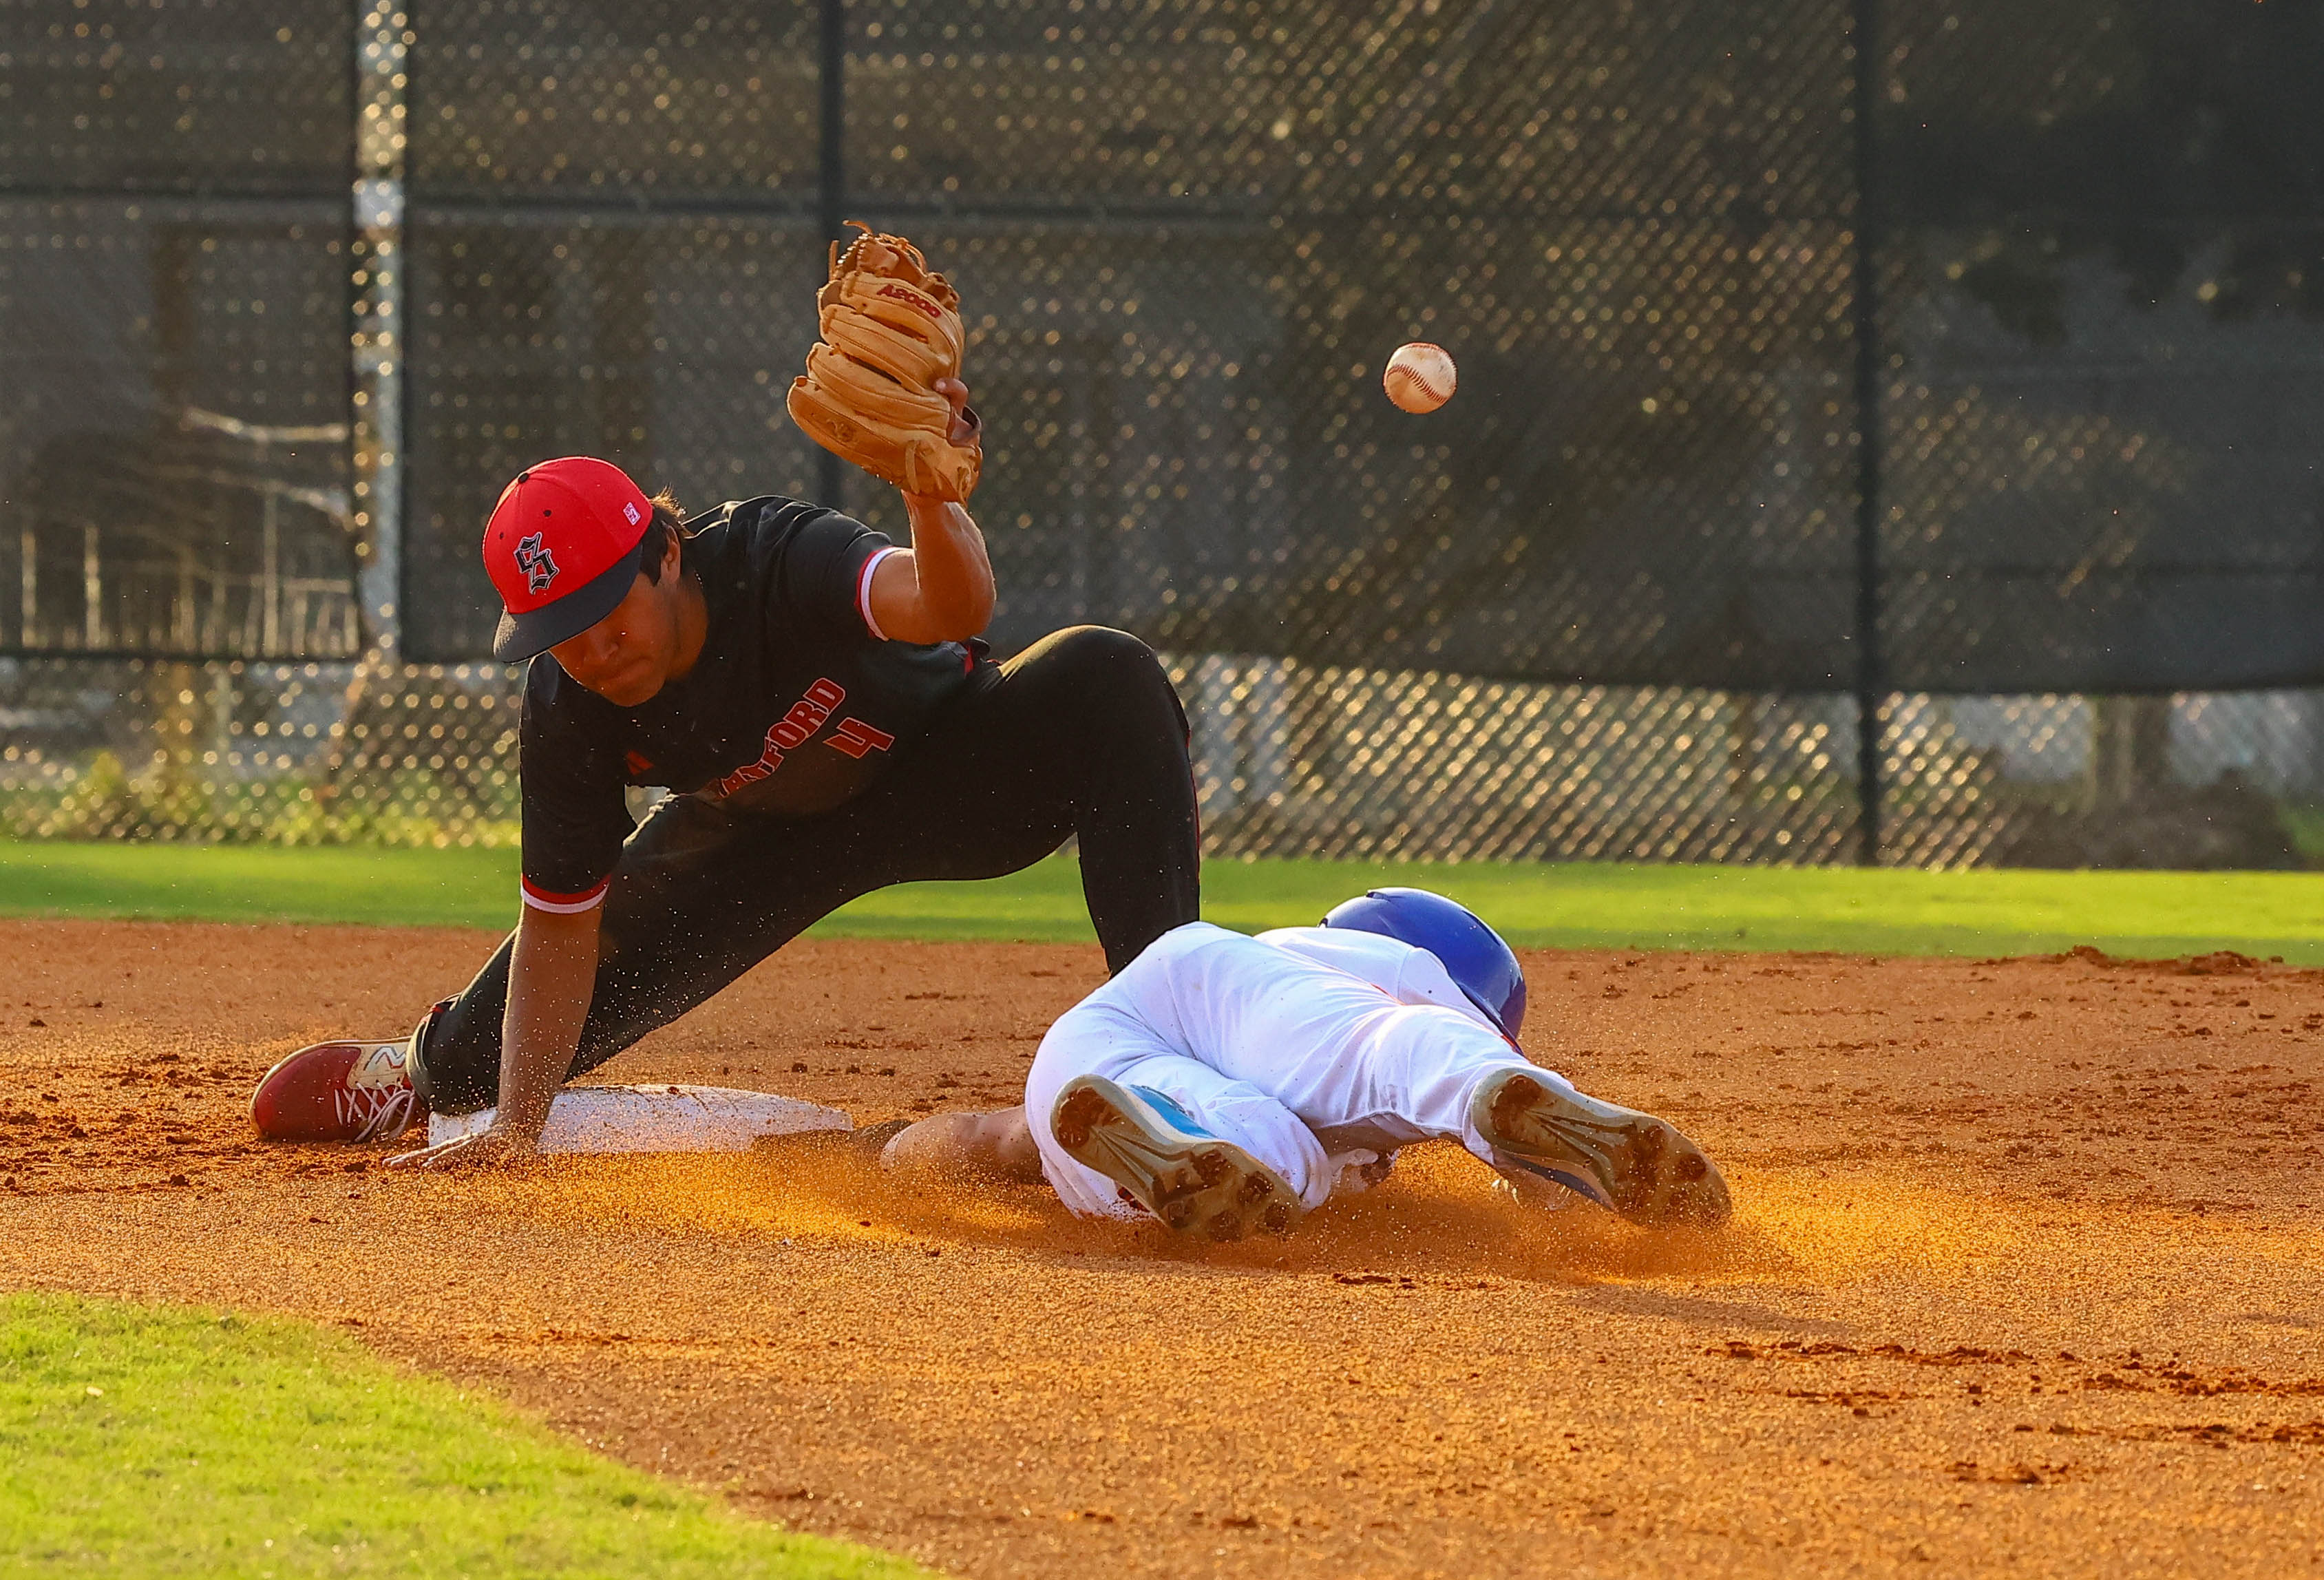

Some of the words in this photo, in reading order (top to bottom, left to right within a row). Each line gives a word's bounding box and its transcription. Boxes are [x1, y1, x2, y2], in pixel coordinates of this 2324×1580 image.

[876, 284, 941, 318] A2000
[513, 531, 560, 595] S
[822, 716, 895, 759] 4
